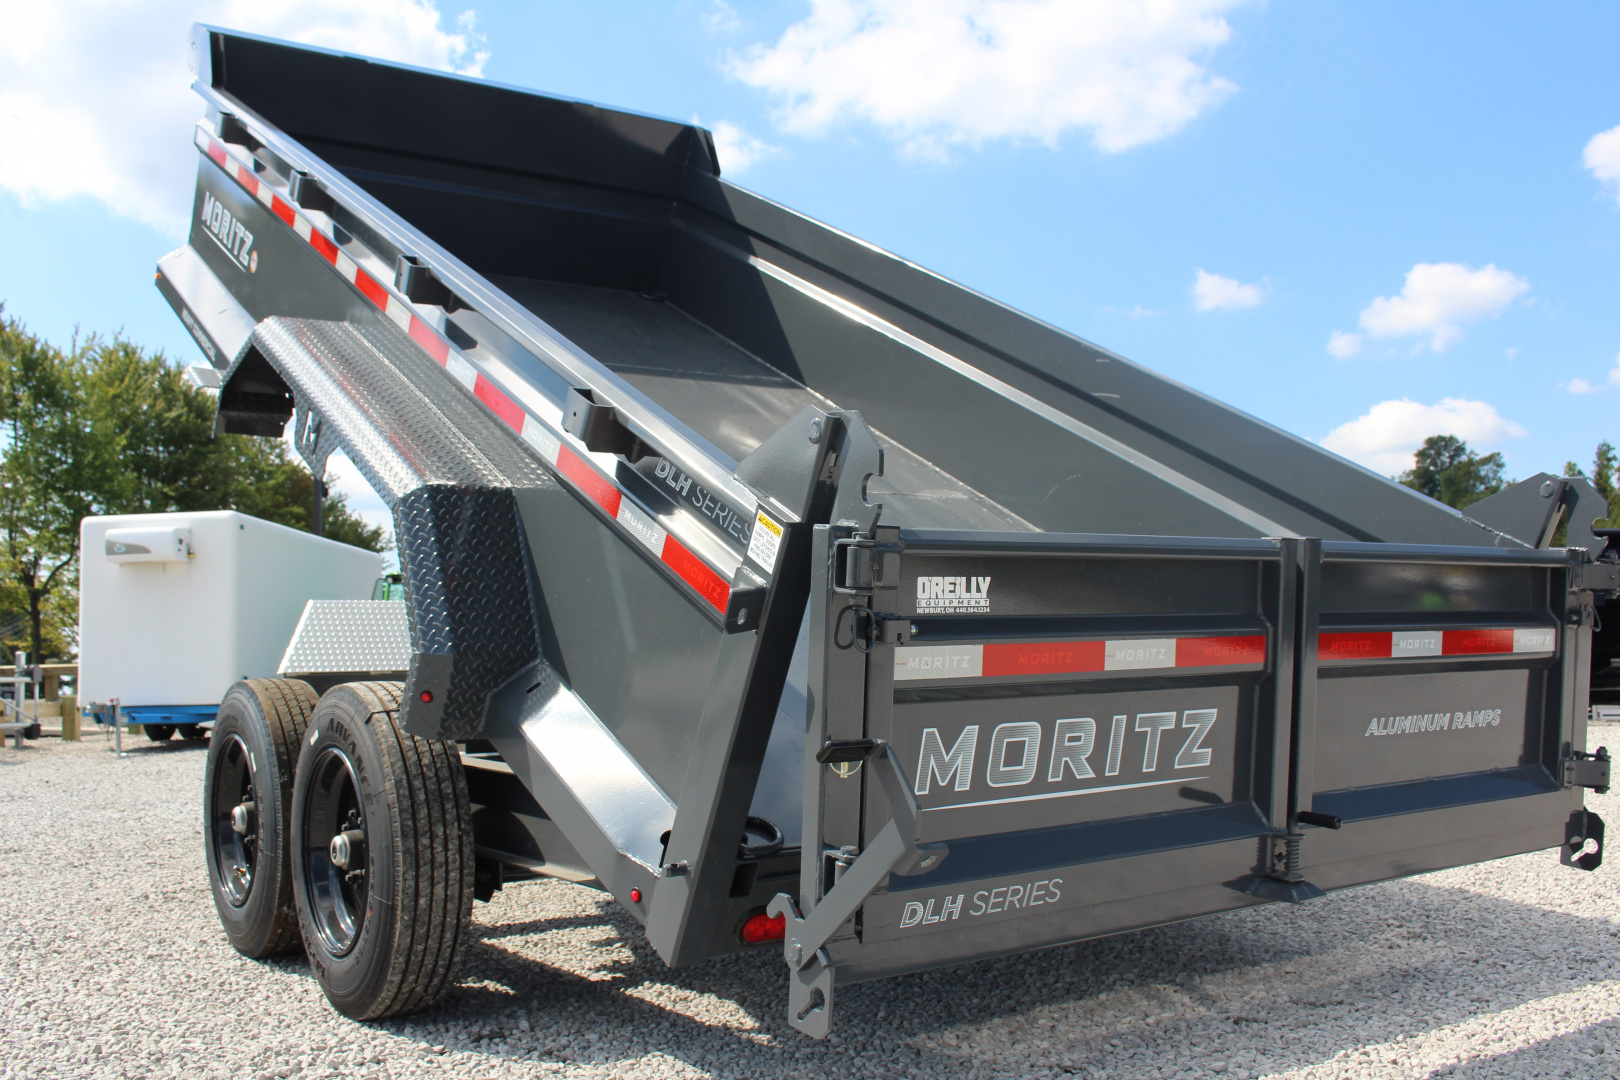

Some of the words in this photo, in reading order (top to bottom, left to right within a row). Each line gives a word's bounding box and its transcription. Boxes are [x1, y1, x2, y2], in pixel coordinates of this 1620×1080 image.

[202, 191, 254, 266] MORITZ
[655, 457, 692, 496] DLH
[692, 486, 752, 544] SERIES
[761, 516, 781, 537] CAUTION
[683, 561, 721, 598] MORITZ
[1332, 640, 1371, 652] MORITZ
[1399, 639, 1435, 650] MORITZ
[1462, 637, 1495, 648] MORITZ
[1519, 636, 1550, 646] MORITZ
[1116, 648, 1166, 661] MORITZ
[1204, 645, 1250, 658] MORITZ
[908, 656, 971, 669] MORITZ
[1018, 652, 1075, 665] MORITZ
[1365, 713, 1450, 737] ALUMINUM
[1452, 709, 1502, 730] RAMPS
[915, 708, 1218, 795] MORITZ
[900, 894, 964, 928] DLH
[969, 878, 1063, 916] SERIES
